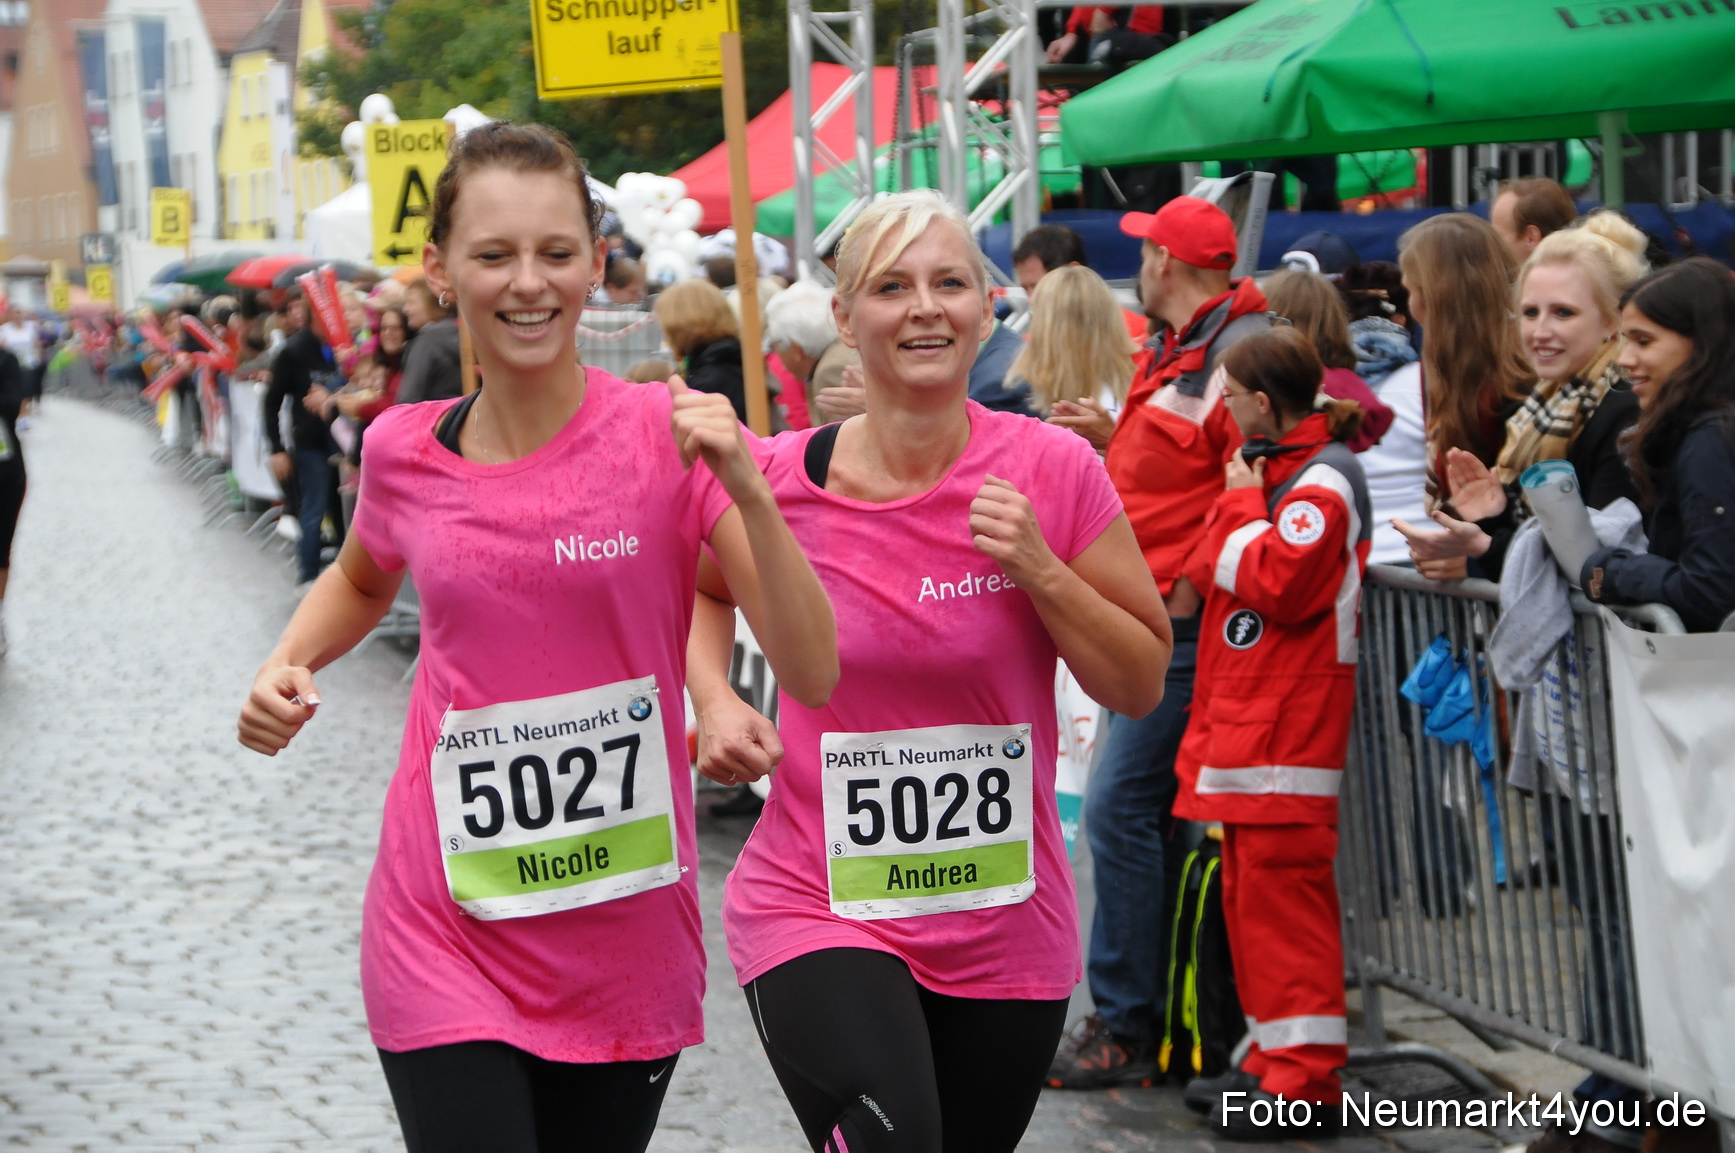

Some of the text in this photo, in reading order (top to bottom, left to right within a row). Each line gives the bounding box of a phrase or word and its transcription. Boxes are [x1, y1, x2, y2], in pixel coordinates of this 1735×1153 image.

[608, 27, 662, 55] lauf
[374, 126, 445, 153] Block
[391, 164, 431, 233] A
[162, 206, 180, 233] B
[554, 530, 639, 565] Nicole
[513, 708, 619, 743] Neumarkt
[826, 743, 994, 768] PARTL Neumarkt
[458, 733, 641, 839] 5027
[847, 767, 1012, 846] 5028
[450, 837, 459, 851] S
[834, 843, 843, 855] S
[516, 844, 610, 885] Nicole
[886, 862, 978, 891] Andrea
